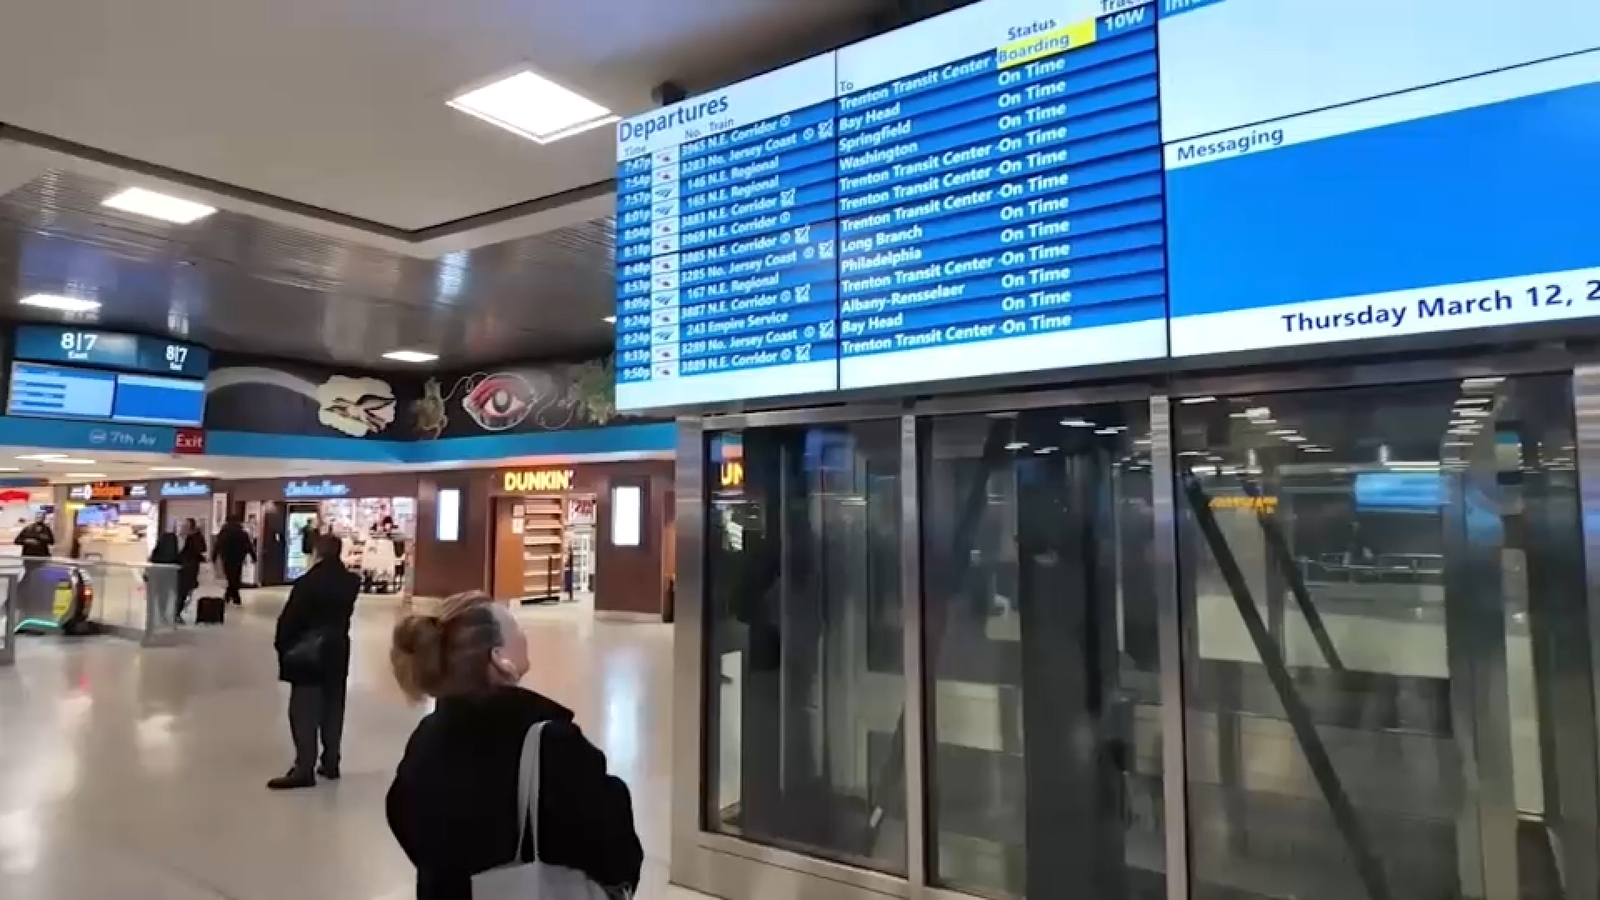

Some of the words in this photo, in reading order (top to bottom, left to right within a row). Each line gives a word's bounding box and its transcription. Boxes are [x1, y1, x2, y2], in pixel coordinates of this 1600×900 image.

[1008, 18, 1056, 40] Status
[730, 121, 777, 142] Corridor
[839, 88, 888, 110] Trenton
[893, 71, 938, 94] Transit
[942, 57, 990, 79] Center
[1000, 34, 1070, 62] Boarding
[1104, 7, 1145, 30] 10W
[840, 81, 853, 91] To
[620, 95, 728, 142] Departures
[709, 118, 734, 132] Train
[728, 145, 762, 161] Jersey
[764, 133, 796, 151] Coast
[839, 116, 862, 130] Bay
[865, 102, 900, 123] Head
[998, 71, 1020, 85] On
[1025, 58, 1065, 77] Time
[731, 156, 778, 179] Regional
[839, 120, 912, 152] Springfield
[998, 93, 1021, 107] On
[1025, 81, 1066, 99] Time
[730, 197, 776, 215] Corridor
[839, 170, 889, 190] Trenton
[893, 156, 938, 176] Transit
[942, 145, 991, 165] Center
[998, 137, 1022, 152] On
[1026, 127, 1067, 145] Time
[731, 175, 778, 197] Regional
[839, 142, 918, 170] Washington
[998, 115, 1021, 129] On
[1025, 104, 1066, 122] Time
[1177, 127, 1284, 161] Messaging
[730, 216, 776, 233] Corridor
[839, 191, 889, 210] Trenton
[893, 177, 938, 198] Transit
[942, 167, 991, 187] Center
[999, 160, 1022, 174] On
[1026, 150, 1067, 167] Time
[730, 236, 776, 253] Corridor
[840, 213, 890, 231] Trenton
[894, 200, 940, 220] Transit
[943, 190, 992, 209] Center
[999, 183, 1023, 197] On
[1027, 174, 1068, 191] Time
[687, 286, 705, 298] 167
[731, 272, 778, 293] Regional
[841, 248, 922, 272] Philadelphia
[1000, 228, 1024, 242] On
[1028, 221, 1070, 237] Time
[729, 259, 762, 273] Jersey
[764, 250, 797, 266] Coast
[841, 238, 872, 253] Long
[875, 225, 922, 245] Branch
[1000, 206, 1023, 220] On
[1028, 197, 1069, 214] Time
[686, 322, 705, 335] 243
[707, 318, 745, 333] Empire
[747, 312, 788, 327] Service
[842, 285, 965, 312] Albany-Rensselaer
[1001, 274, 1025, 288] On
[1028, 268, 1070, 283] Time
[731, 294, 777, 310] Corridor
[841, 276, 890, 292] Trenton
[895, 264, 940, 283] Transit
[944, 257, 993, 275] Center
[1000, 251, 1024, 265] On
[1028, 244, 1070, 260] Time
[729, 335, 763, 348] Jersey
[765, 329, 797, 343] Coast
[841, 320, 865, 334] Bay
[868, 312, 902, 329] Head
[1001, 296, 1025, 310] On
[1029, 291, 1071, 306] Time
[1282, 304, 1406, 332] Thursday
[1418, 290, 1512, 319] March
[1526, 284, 1573, 308] 12,
[731, 351, 777, 366] Corridor
[842, 338, 891, 352] Trenton
[896, 329, 941, 346] Transit
[945, 324, 995, 340] Center
[1001, 319, 1025, 333] On
[1029, 314, 1072, 329] Time
[110, 432, 134, 446] 7th
[176, 434, 203, 448] Exit
[504, 470, 574, 490] DUNKIN'
